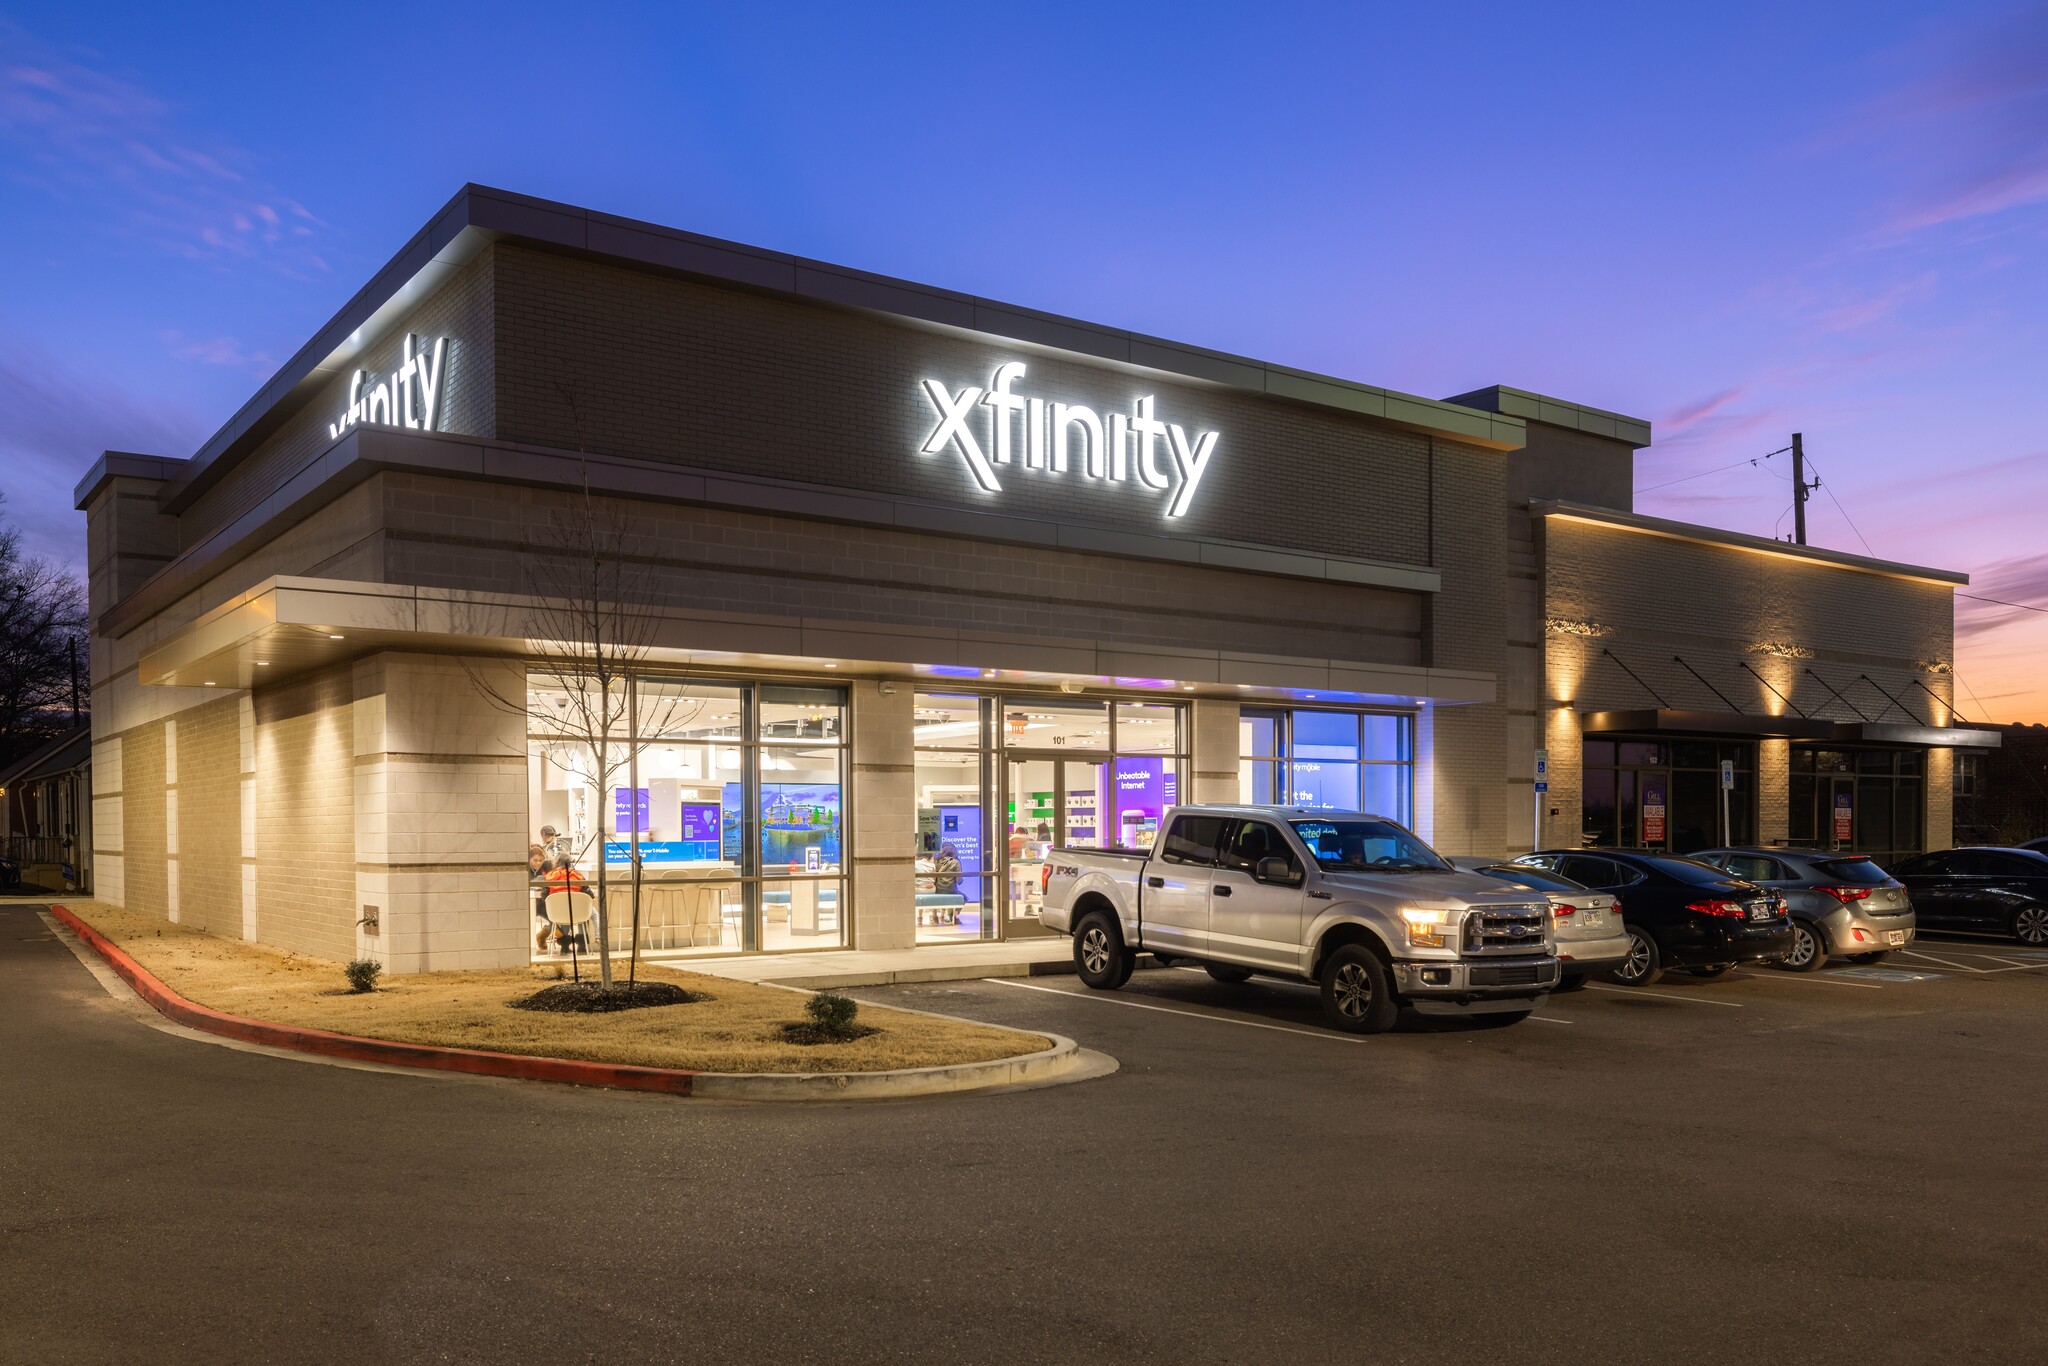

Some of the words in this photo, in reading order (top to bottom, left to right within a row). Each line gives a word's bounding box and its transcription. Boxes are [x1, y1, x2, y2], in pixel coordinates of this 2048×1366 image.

[921, 361, 1220, 518] xfinity
[1053, 736, 1065, 745] 101
[1121, 781, 1145, 790] Internet
[1300, 790, 1313, 801] the
[1645, 806, 1664, 816] AVAILABLE
[1056, 866, 1079, 877] FX4
